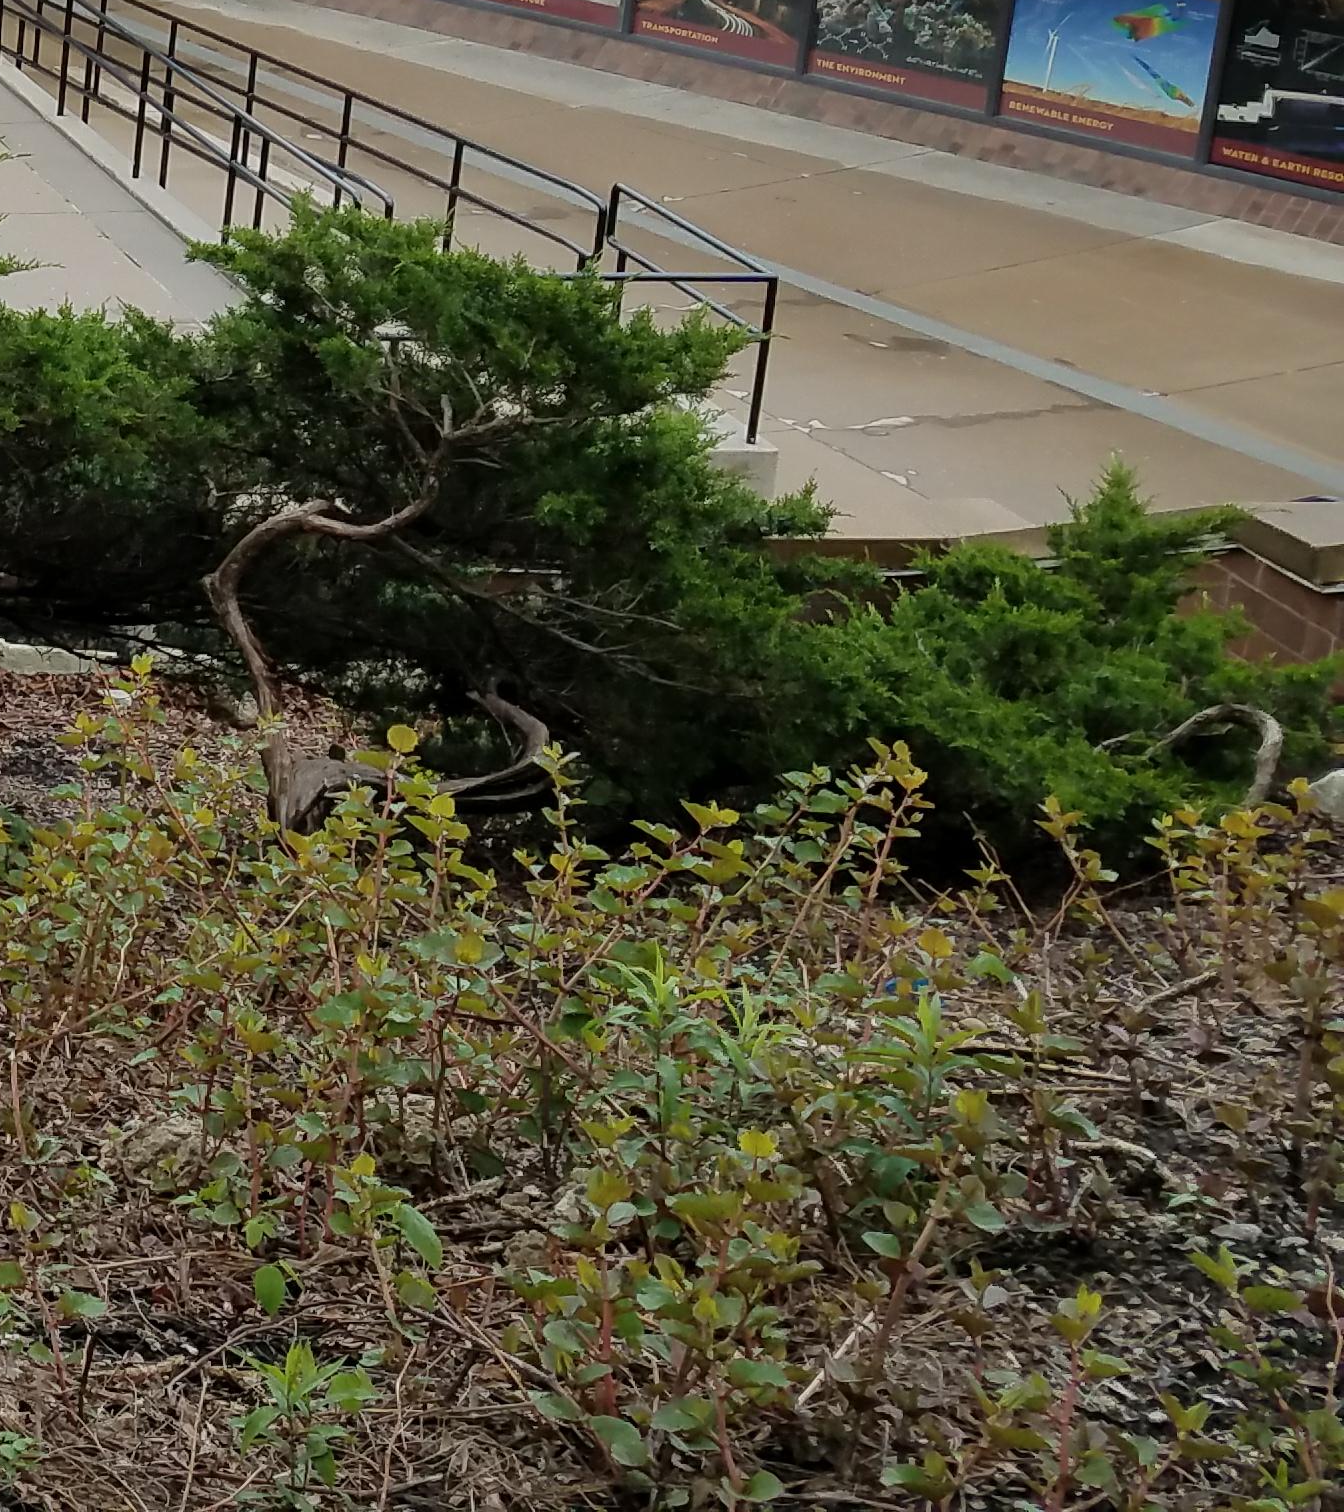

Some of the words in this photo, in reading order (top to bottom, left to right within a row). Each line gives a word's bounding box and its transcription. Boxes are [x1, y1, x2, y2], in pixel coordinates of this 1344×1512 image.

[641, 20, 719, 44] TRANSPORTATION
[816, 58, 835, 71] THE
[836, 61, 906, 86] ENVIRONMENT
[1009, 100, 1070, 123] RENEWABLE
[1071, 114, 1114, 131] ENERGY
[1223, 147, 1259, 163] WATER
[1261, 157, 1270, 166] &
[1272, 159, 1311, 175] EARTH
[1313, 168, 1344, 183] RESO
